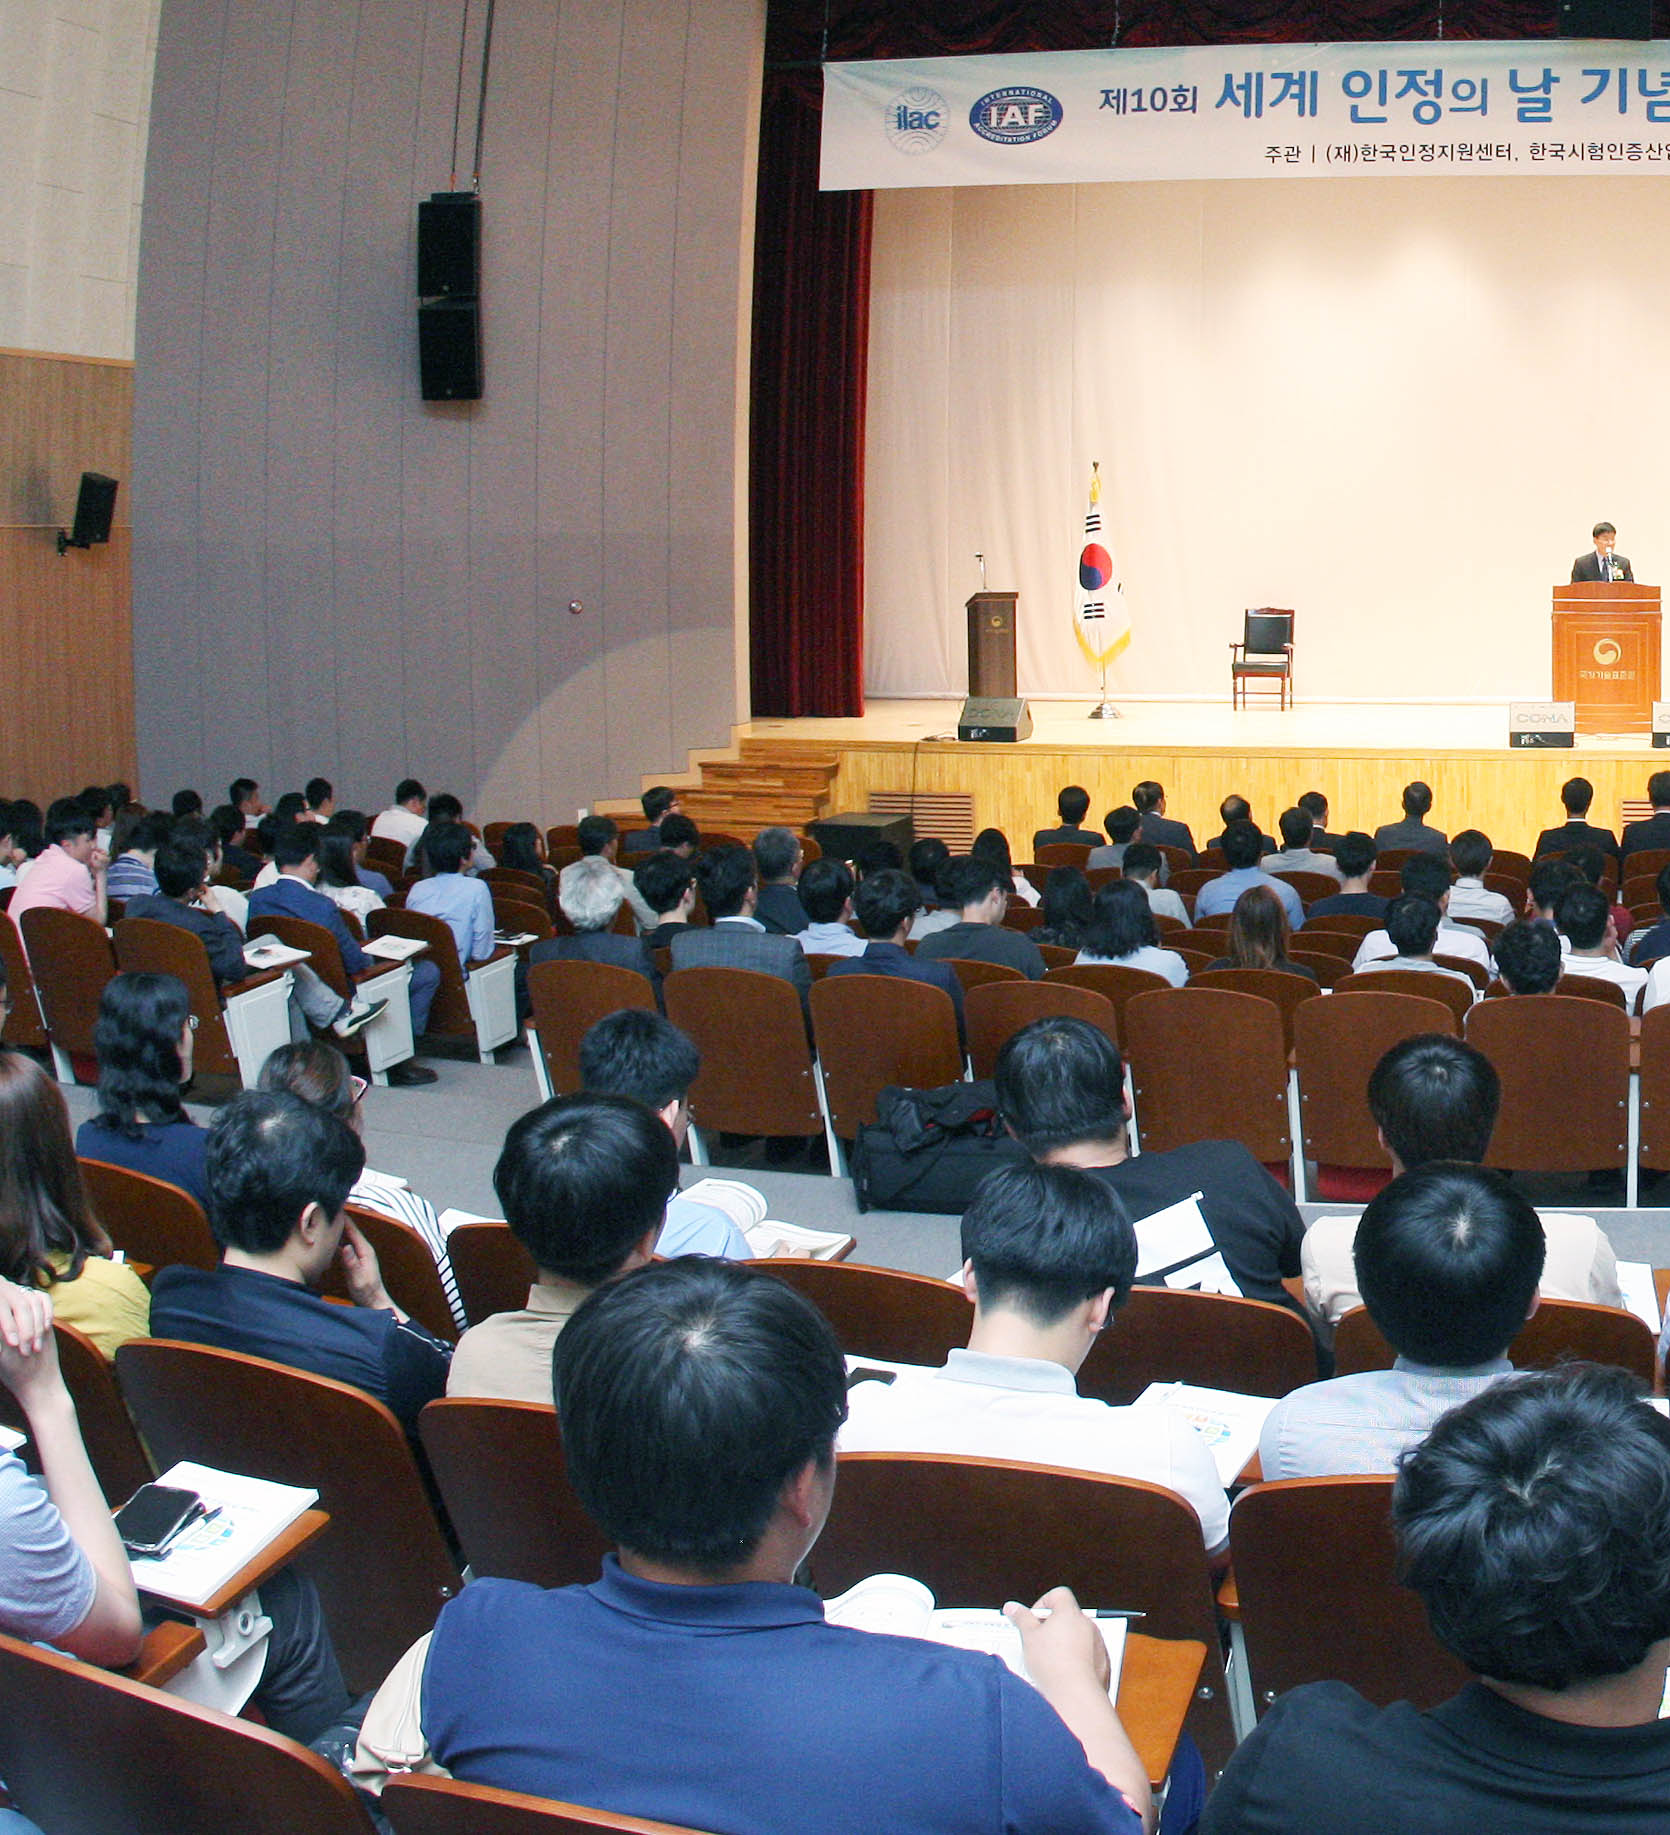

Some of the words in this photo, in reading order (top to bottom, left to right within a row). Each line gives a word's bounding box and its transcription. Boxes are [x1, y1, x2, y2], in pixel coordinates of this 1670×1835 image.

[981, 88, 1053, 105] INTERNATIONAL
[1098, 83, 1198, 116] 제10회
[1214, 70, 1319, 119] 세계
[1341, 68, 1489, 126] 인정의
[1508, 67, 1561, 123] 날
[896, 104, 941, 131] ilac
[989, 103, 1044, 129] IAF
[974, 122, 1031, 143] ACCREDITATION
[1033, 119, 1058, 139] FORUM
[1264, 144, 1302, 165] 주관
